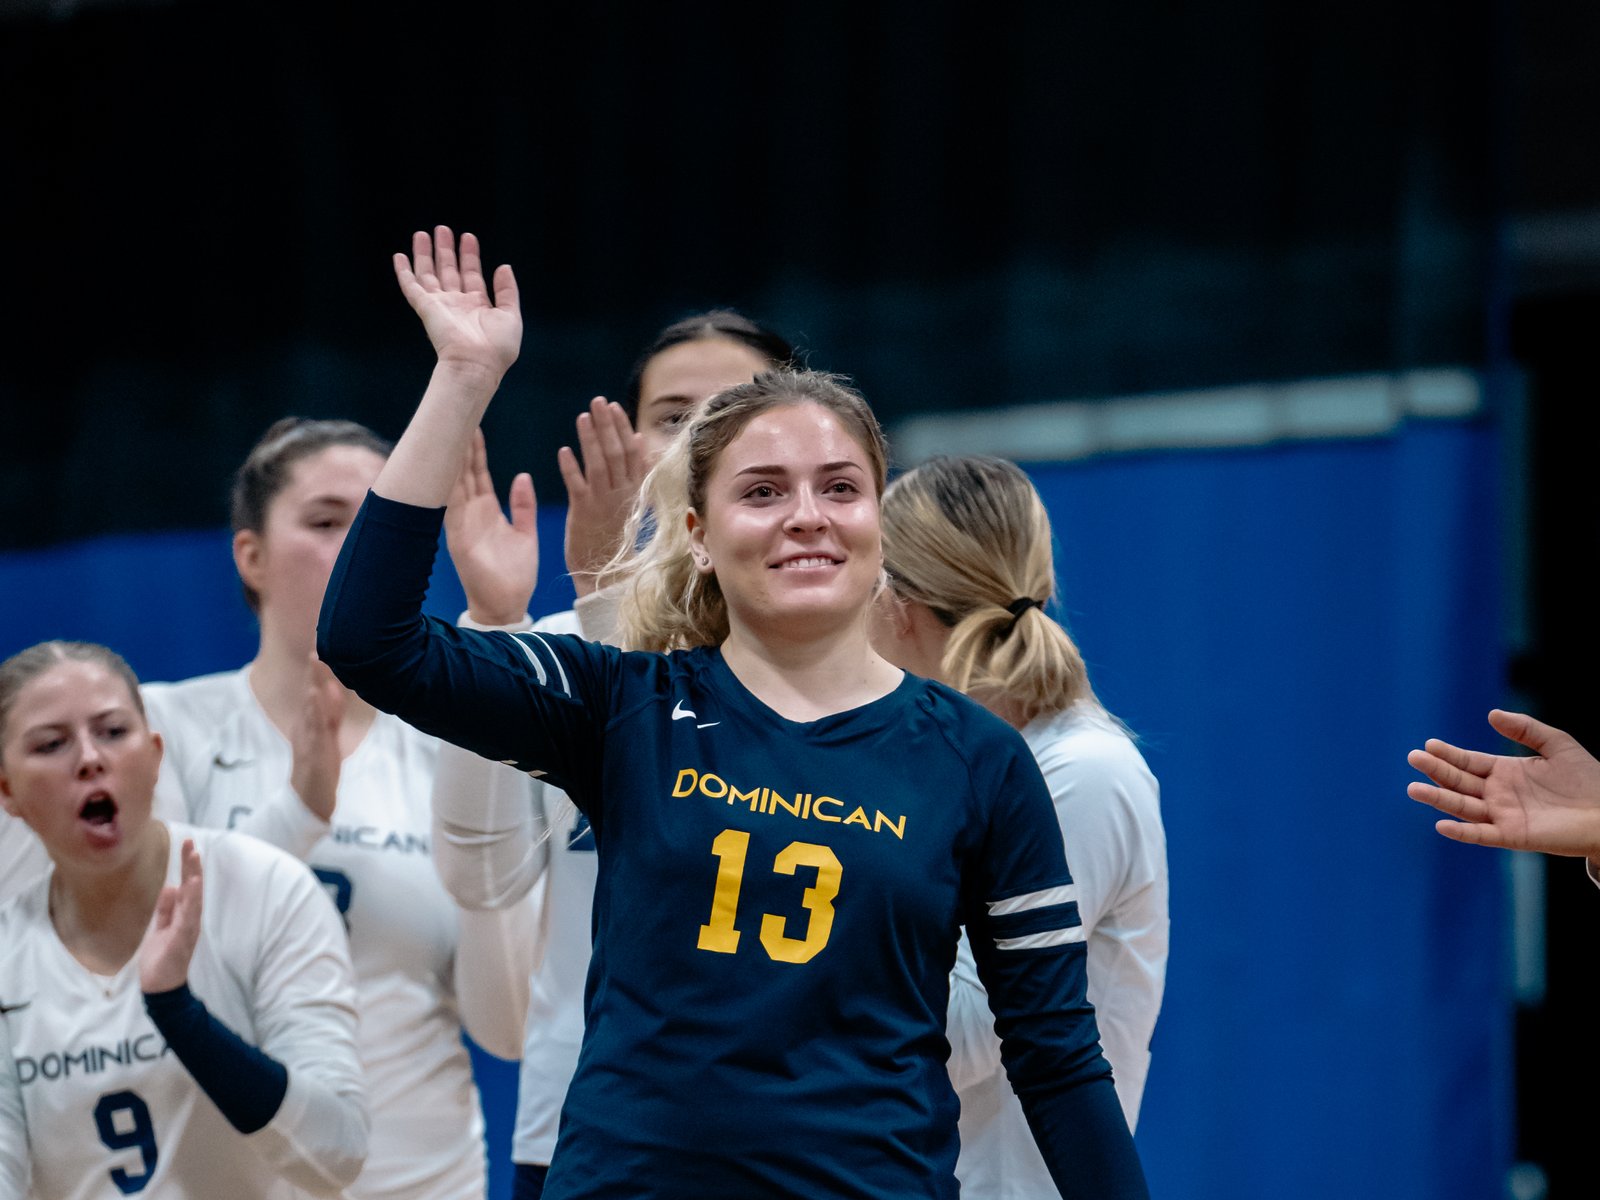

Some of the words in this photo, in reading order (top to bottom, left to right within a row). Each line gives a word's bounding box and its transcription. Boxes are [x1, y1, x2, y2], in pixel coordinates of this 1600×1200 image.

[672, 768, 906, 840] DOMINICAN
[697, 829, 843, 964] 13
[15, 1033, 170, 1084] DOMINIC
[94, 1090, 157, 1196] 9
